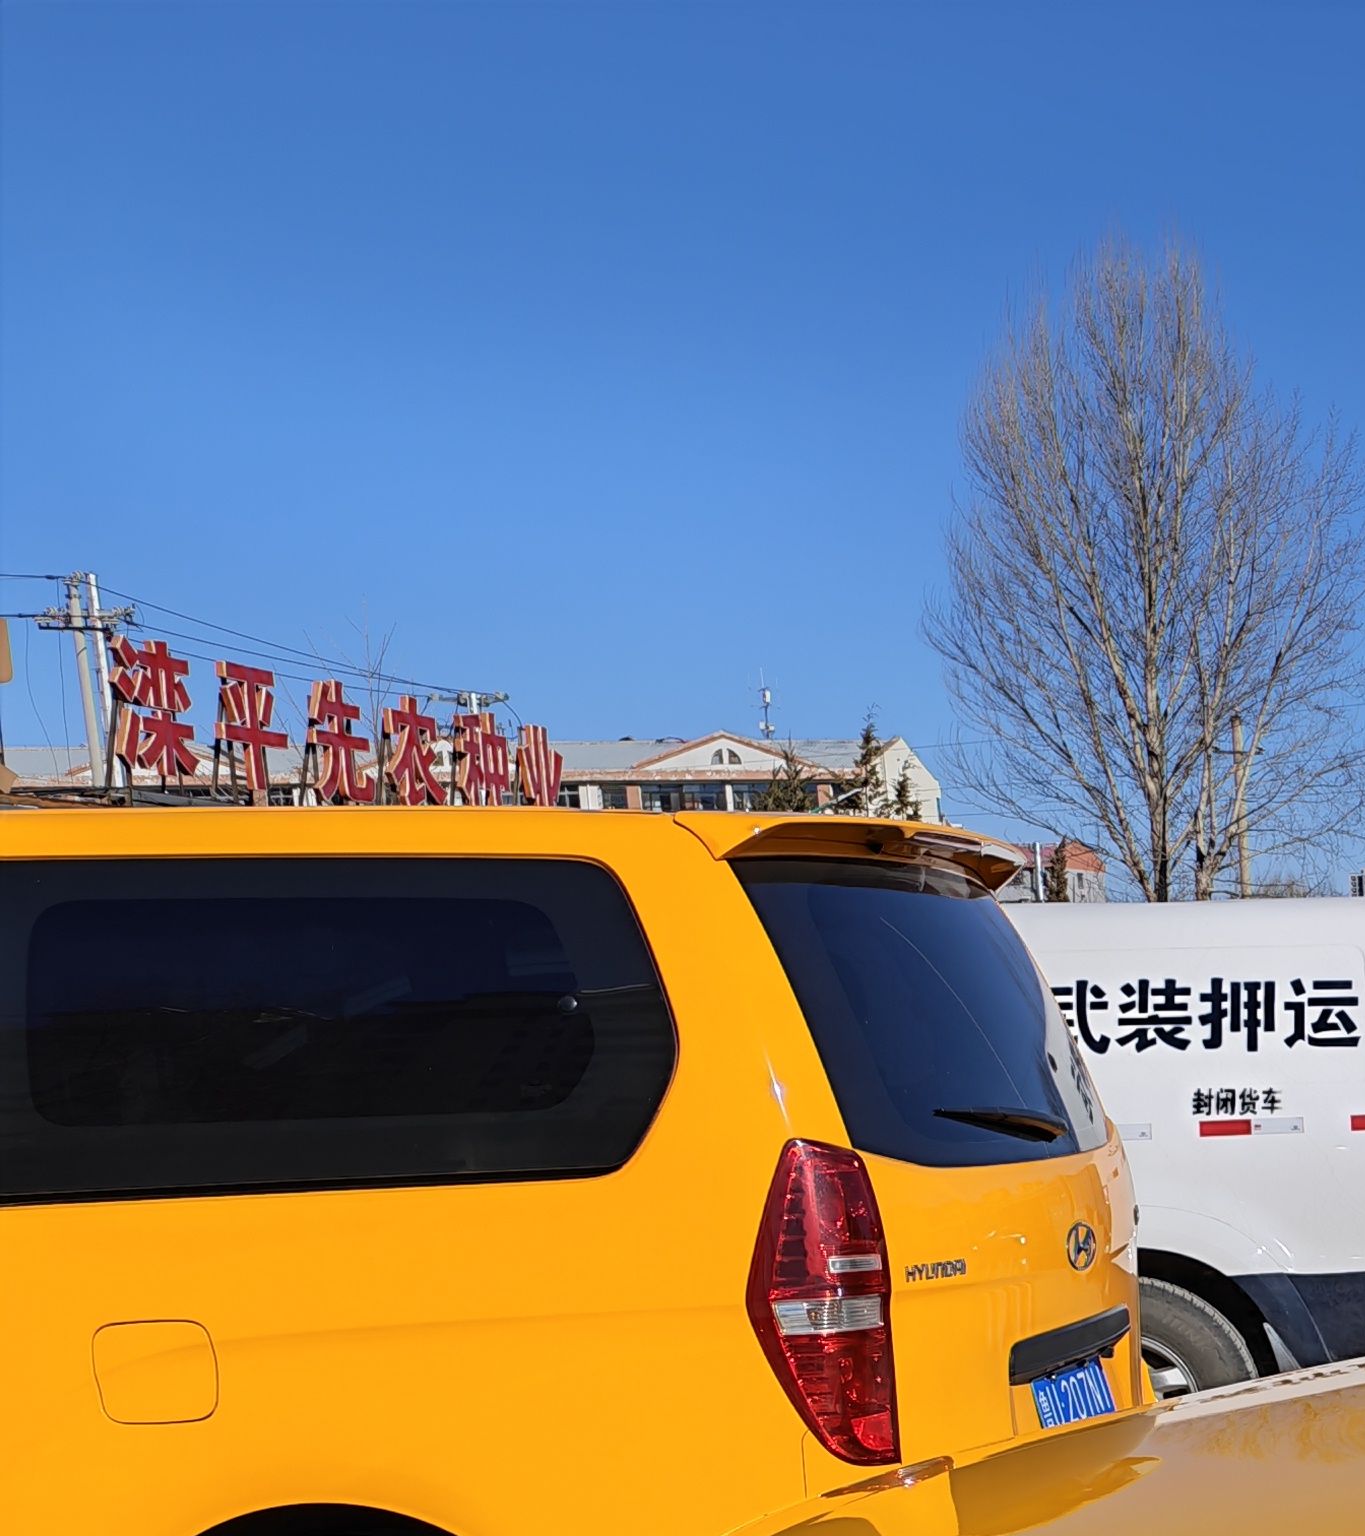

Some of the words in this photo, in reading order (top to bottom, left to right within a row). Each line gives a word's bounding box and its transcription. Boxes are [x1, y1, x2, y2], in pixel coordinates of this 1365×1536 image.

[1051, 977, 1361, 1053] 武装押运
[1192, 1087, 1283, 1116] 封闭货车
[905, 1258, 966, 1283] HYUNDAI
